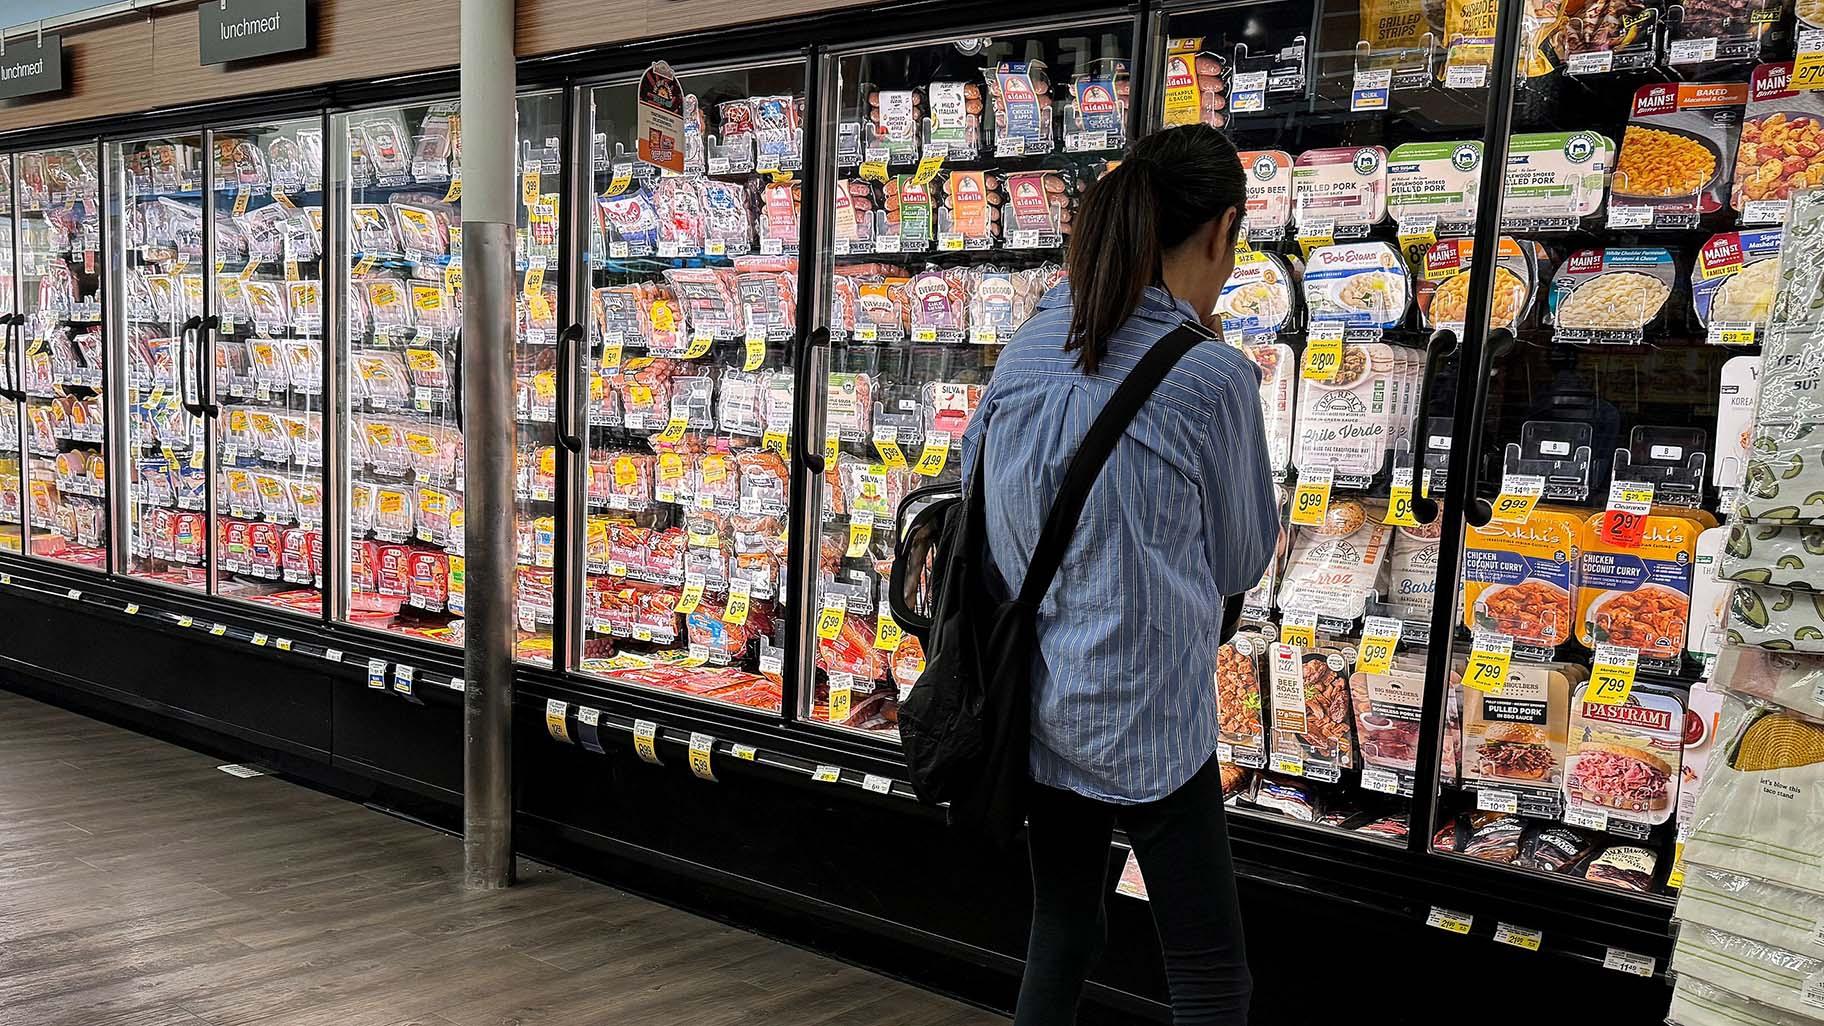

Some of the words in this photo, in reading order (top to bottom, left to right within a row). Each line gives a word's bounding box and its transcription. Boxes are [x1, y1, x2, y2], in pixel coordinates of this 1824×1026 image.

[220, 12, 280, 40] lunchmeat
[1379, 14, 1420, 29] GRILLED
[1379, 25, 1415, 40] STRIPS
[1, 58, 43, 80] lunchmeat
[1756, 76, 1785, 91] MAIN
[1696, 88, 1727, 96] BAKED
[1637, 96, 1665, 108] MAIN
[1665, 94, 1675, 103] ST
[1333, 182, 1357, 190] PORK
[1749, 240, 1773, 248] Mashed
[1238, 254, 1254, 262] SIZE
[1320, 252, 1344, 265] Bob
[1346, 250, 1377, 262] Evans
[1429, 250, 1450, 262] MAIN
[1450, 248, 1457, 257] ST
[1705, 248, 1731, 261] MAIN
[1730, 244, 1738, 252] ST
[1570, 255, 1593, 267] MAIN
[1593, 255, 1601, 263] ST
[1233, 267, 1261, 279] Evans
[1428, 269, 1444, 278] FAMILY
[1446, 268, 1456, 276] SIZE
[1706, 267, 1726, 278] FAMILY
[1726, 265, 1739, 274] SIZE
[919, 283, 946, 295] EVERGOOD
[982, 285, 1011, 296] EVERGOOD
[942, 385, 960, 394] SILVA
[1731, 397, 1754, 405] KOREA
[1338, 423, 1383, 439] Verde
[825, 447, 834, 458] 99
[883, 447, 900, 460] 699
[922, 455, 941, 468] 499
[860, 475, 879, 484] SILVA
[1299, 492, 1322, 511] 999
[1499, 499, 1528, 511] 999
[1610, 513, 1642, 534] 297
[1467, 551, 1497, 561] CHICKEN
[1583, 553, 1614, 565] CHICKEN
[1467, 559, 1498, 569] COCONUT
[1500, 562, 1523, 572] CURRY
[1583, 563, 1615, 574] COCONUT
[1617, 566, 1640, 577] CURRY
[1400, 578, 1435, 594] Barb
[729, 601, 746, 615] 699
[822, 615, 840, 630] 699
[881, 625, 897, 641] 699
[1365, 645, 1387, 663] 999
[1474, 662, 1501, 680] 799
[1277, 685, 1299, 693] ROAST
[1278, 678, 1297, 687] BEEF
[1596, 676, 1625, 695] 799
[833, 695, 847, 710] 449
[1488, 705, 1518, 714] PULLED
[1519, 707, 1542, 716] PORK
[1584, 703, 1670, 729] PASTRAMI
[693, 758, 708, 772] 599
[1760, 777, 1772, 786] let's
[1773, 781, 1788, 790] blow
[1788, 785, 1801, 794] this
[1763, 786, 1776, 795] taco
[1777, 789, 1794, 800] stand
